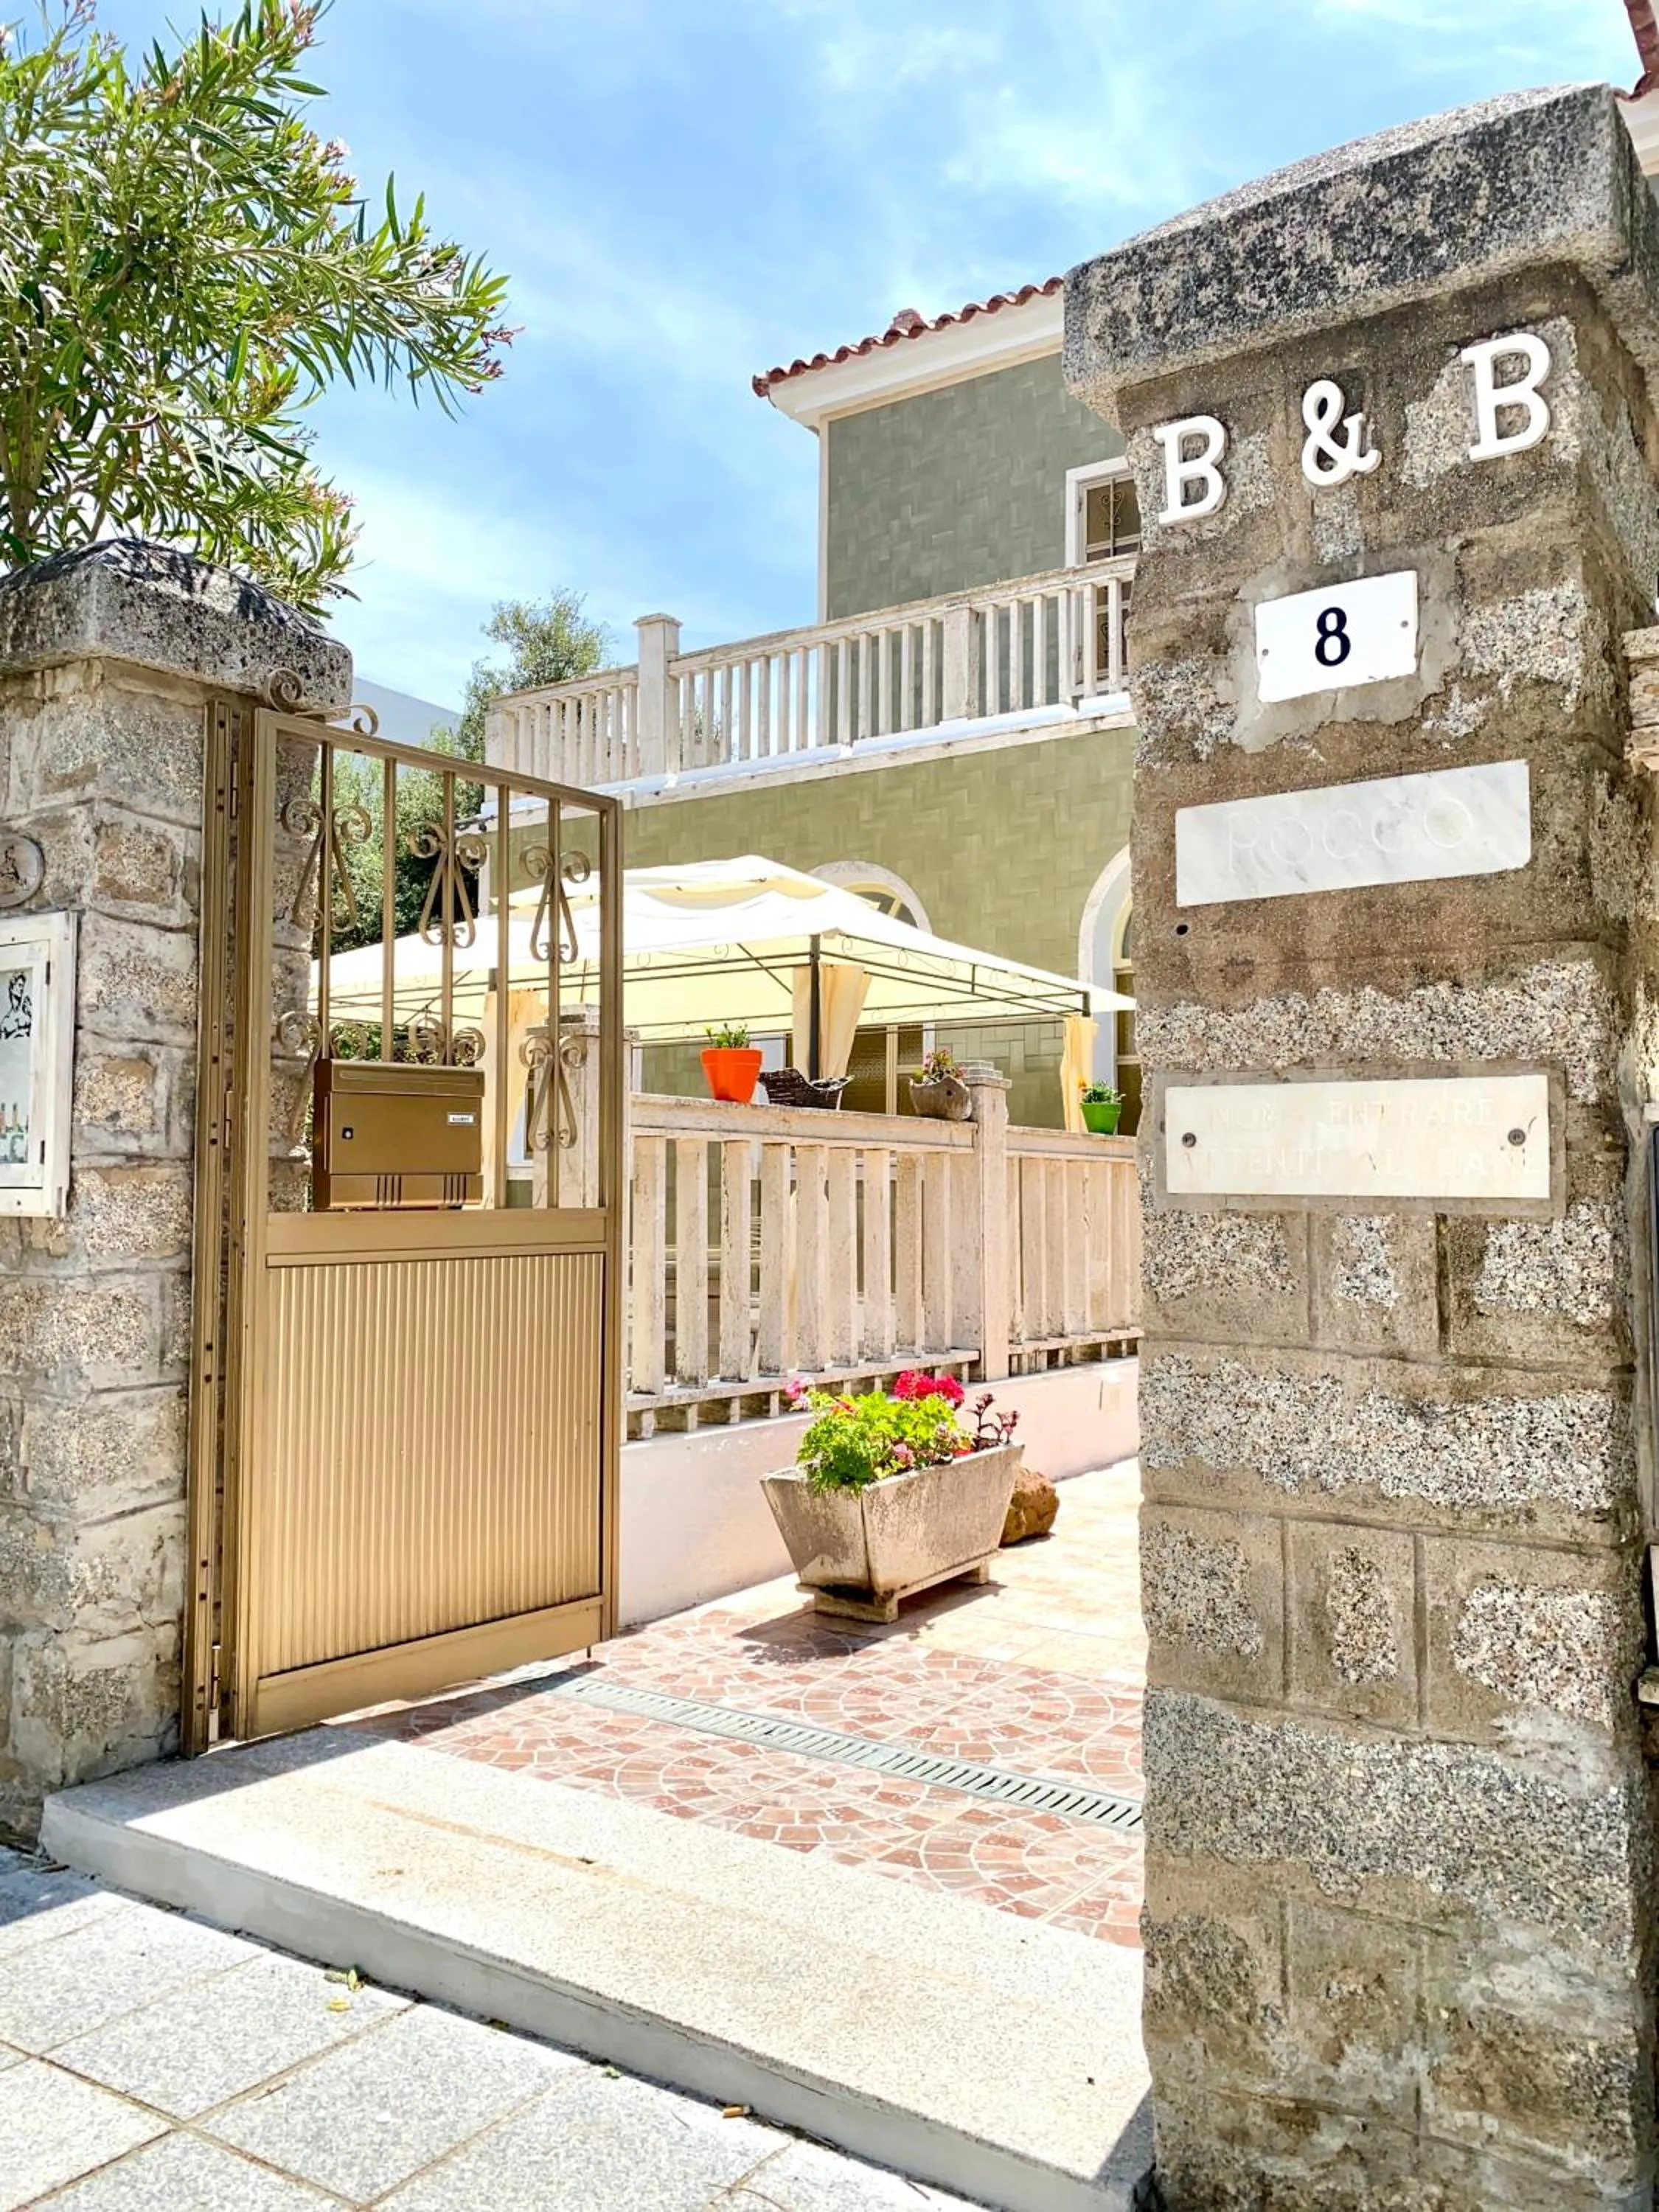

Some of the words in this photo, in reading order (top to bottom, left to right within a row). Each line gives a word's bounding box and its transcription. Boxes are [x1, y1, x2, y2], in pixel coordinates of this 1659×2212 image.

[1153, 414, 1228, 525] B
[1301, 379, 1382, 487] &
[1461, 332, 1551, 462] B
[1314, 606, 1352, 667] 8
[1225, 796, 1473, 874] ROCCO
[1328, 1097, 1497, 1127] ENTRARE
